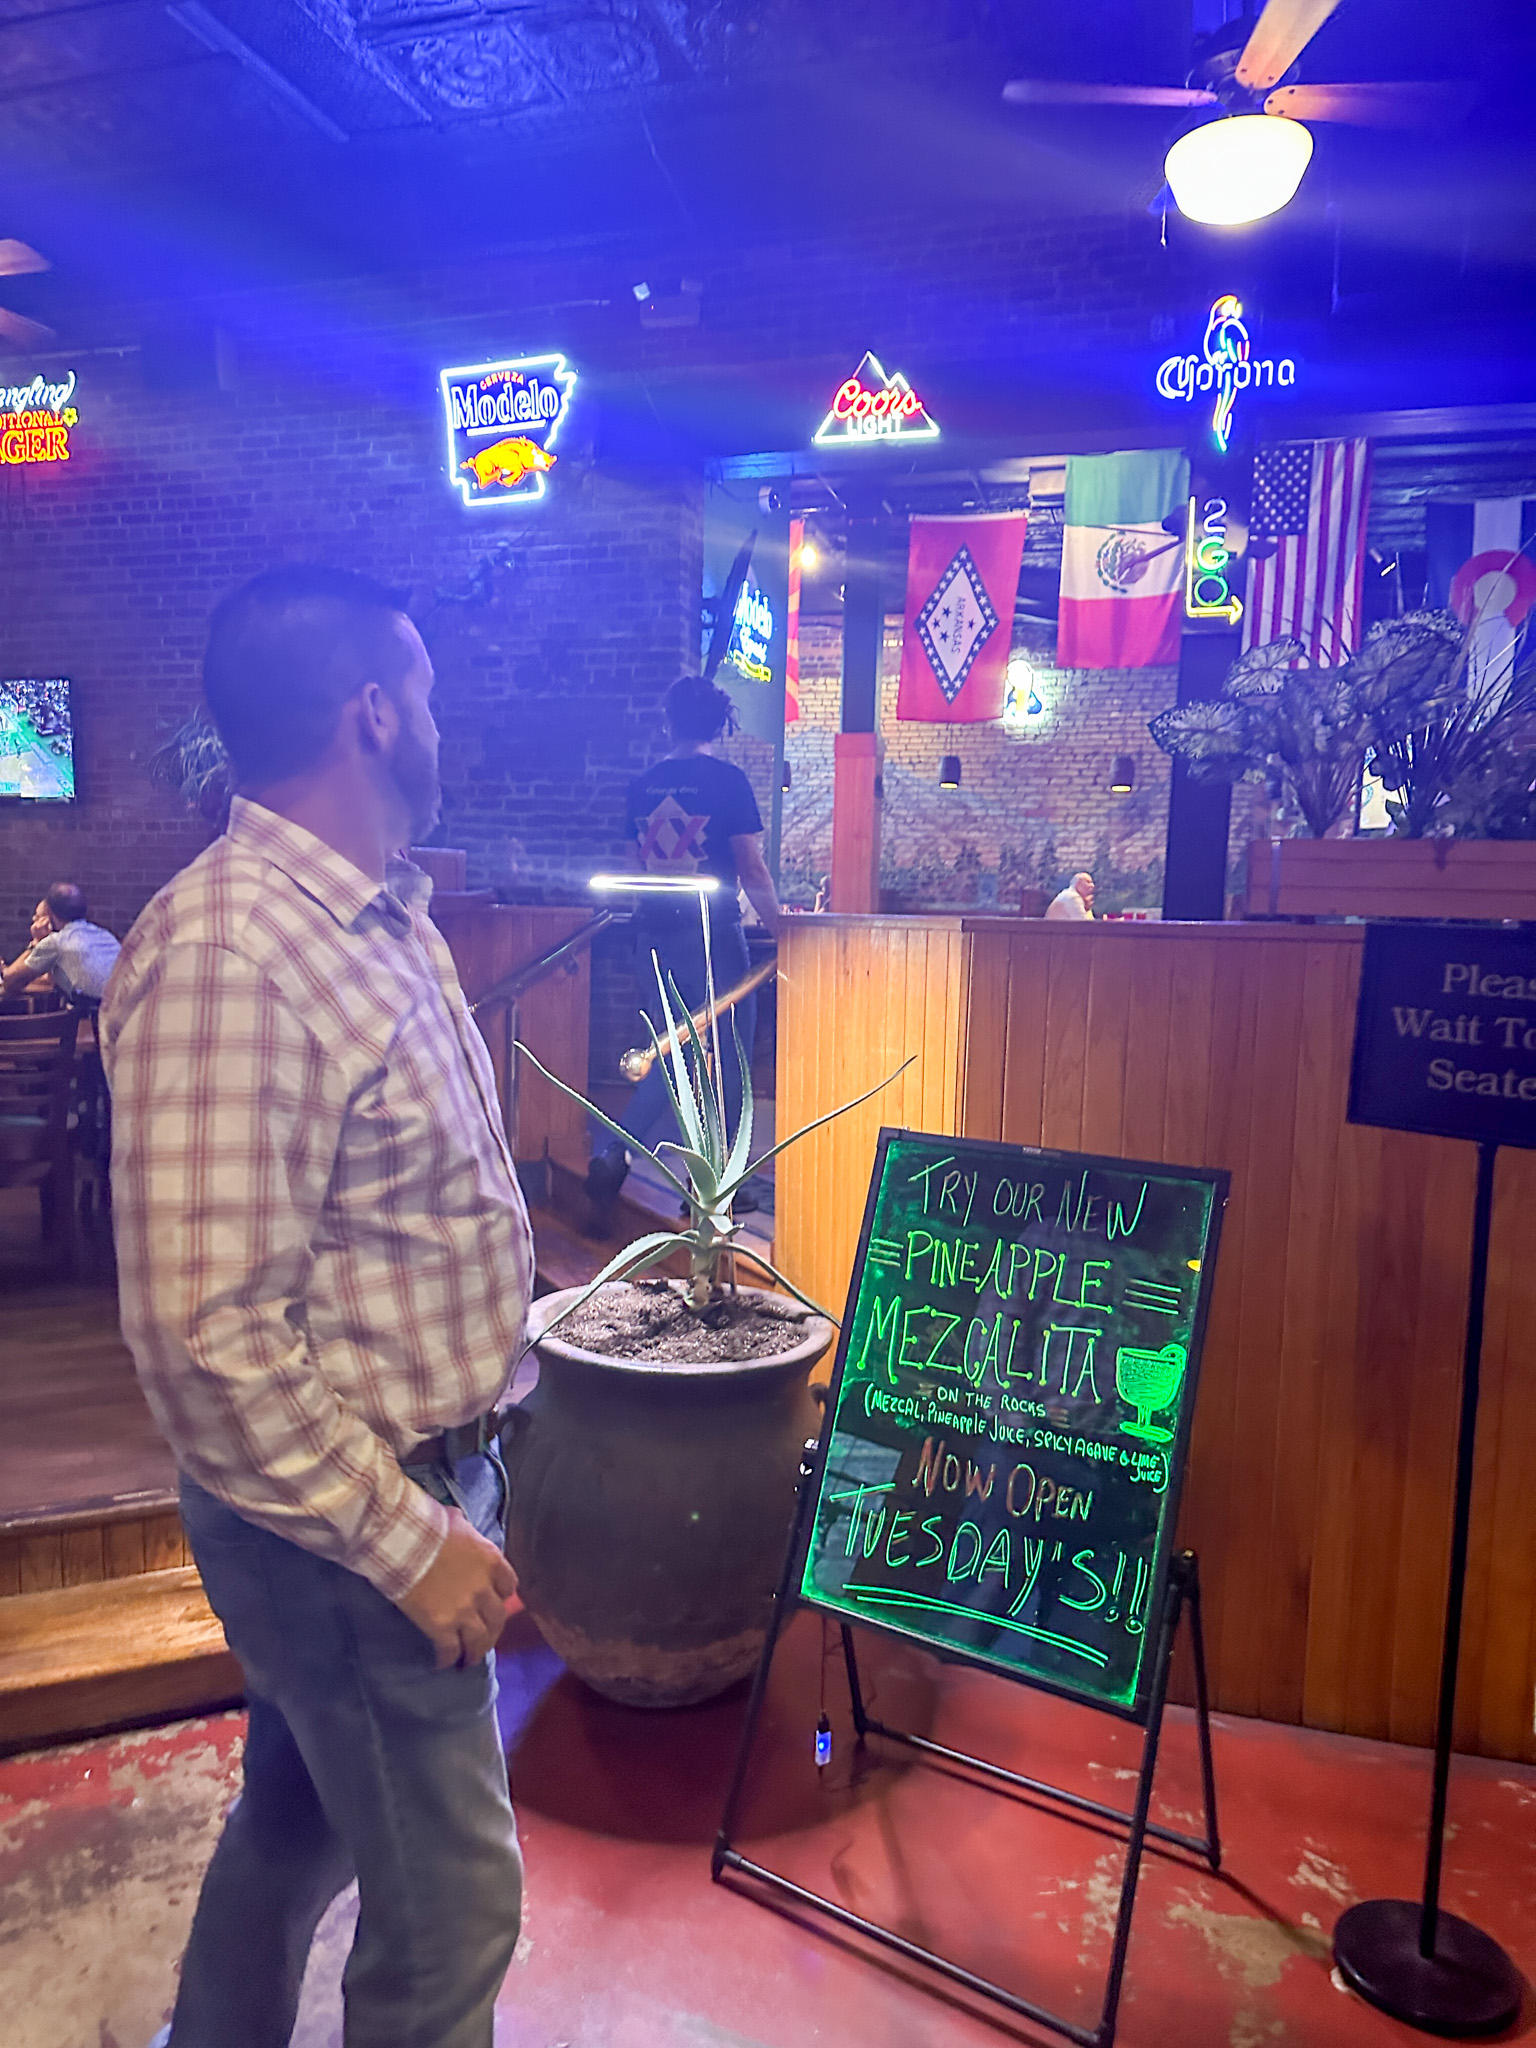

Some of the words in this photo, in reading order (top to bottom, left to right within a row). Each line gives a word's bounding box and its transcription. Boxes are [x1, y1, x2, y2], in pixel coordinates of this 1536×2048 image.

[480, 371, 524, 391] CERVEZA
[833, 378, 923, 419] Coors
[1155, 354, 1295, 402] Corona
[0, 410, 64, 431] ITIONAL
[451, 378, 559, 430] Modelo
[847, 412, 904, 436] LIGHT
[951, 596, 966, 654] ARKANSAS
[1391, 1006, 1483, 1045] Wait
[908, 1156, 978, 1227] TRY
[993, 1177, 1046, 1222] OUR
[1055, 1170, 1148, 1240] NEW
[904, 1230, 1114, 1313] PINEAPPLE
[857, 1295, 1102, 1403] MEZCALITA
[937, 1386, 959, 1403] ON
[965, 1392, 992, 1409] THE
[1000, 1394, 1046, 1417] ROCKS
[1034, 1430, 1072, 1455] SPICY
[1075, 1438, 1118, 1461] AGAVE
[912, 1436, 996, 1501] NOW
[1006, 1464, 1093, 1521] OPEN
